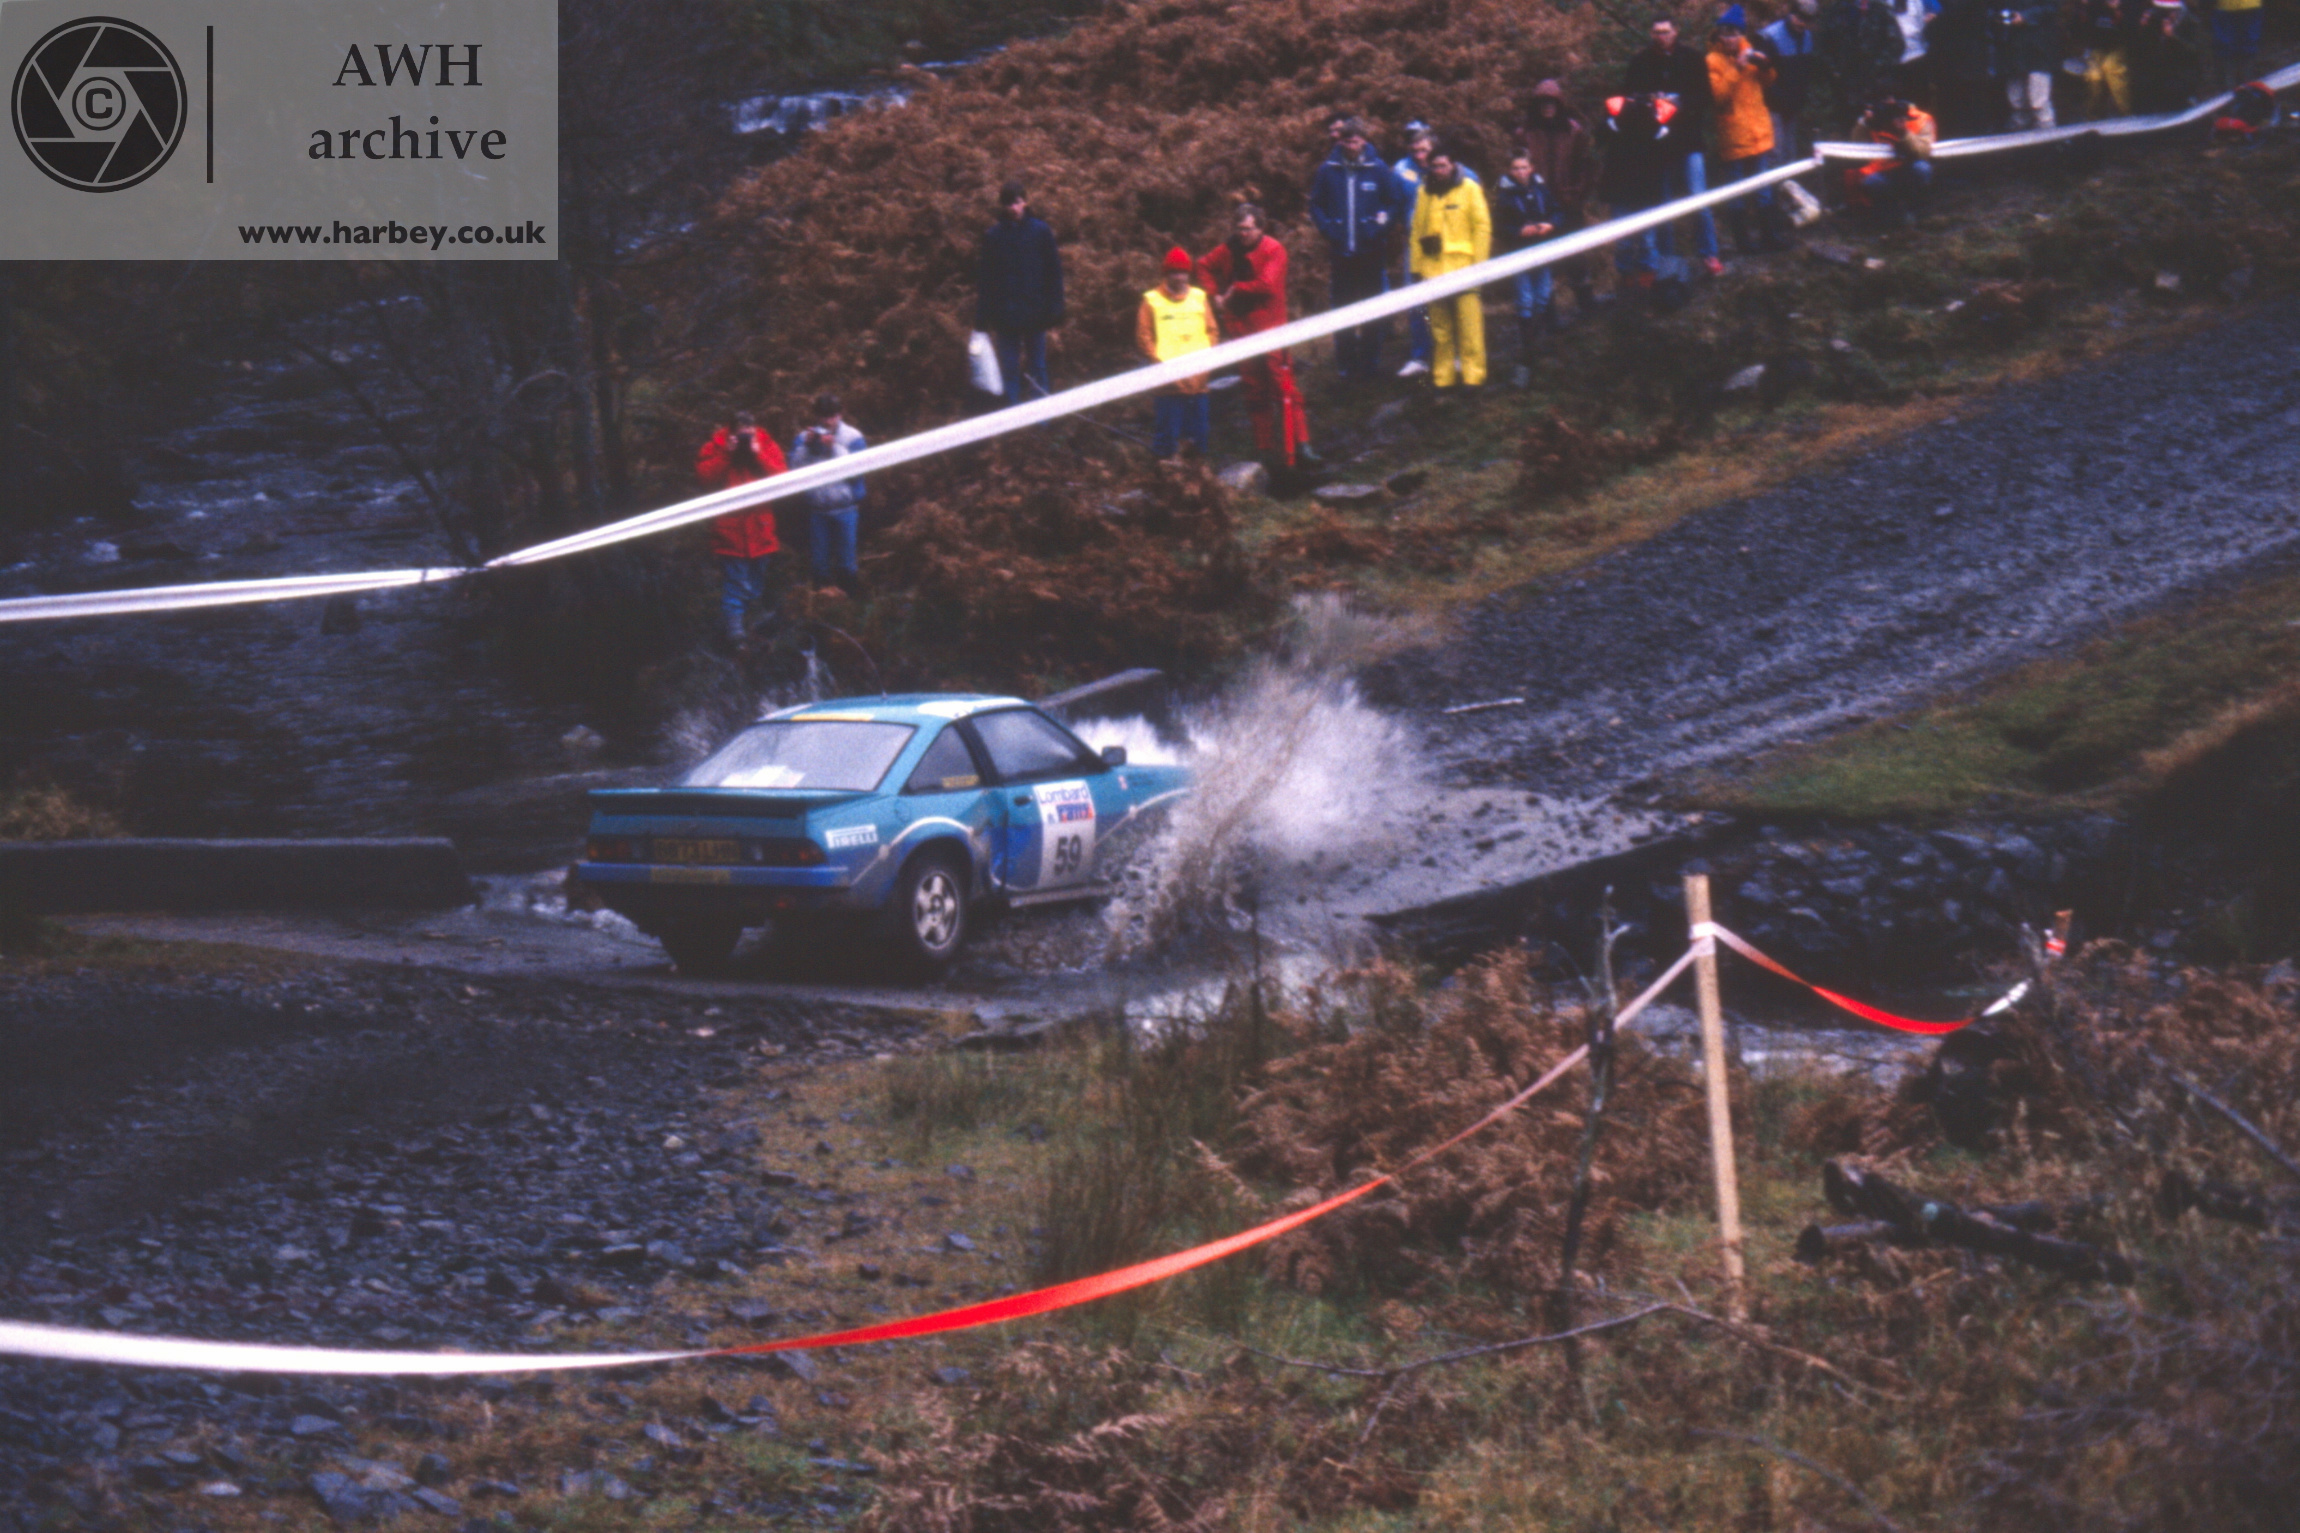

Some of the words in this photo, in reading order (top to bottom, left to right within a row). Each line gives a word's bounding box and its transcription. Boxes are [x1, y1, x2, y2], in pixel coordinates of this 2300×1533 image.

[1038, 787, 1090, 804] Lombard
[825, 823, 878, 849] PIRELLI
[1054, 834, 1082, 876] 59
